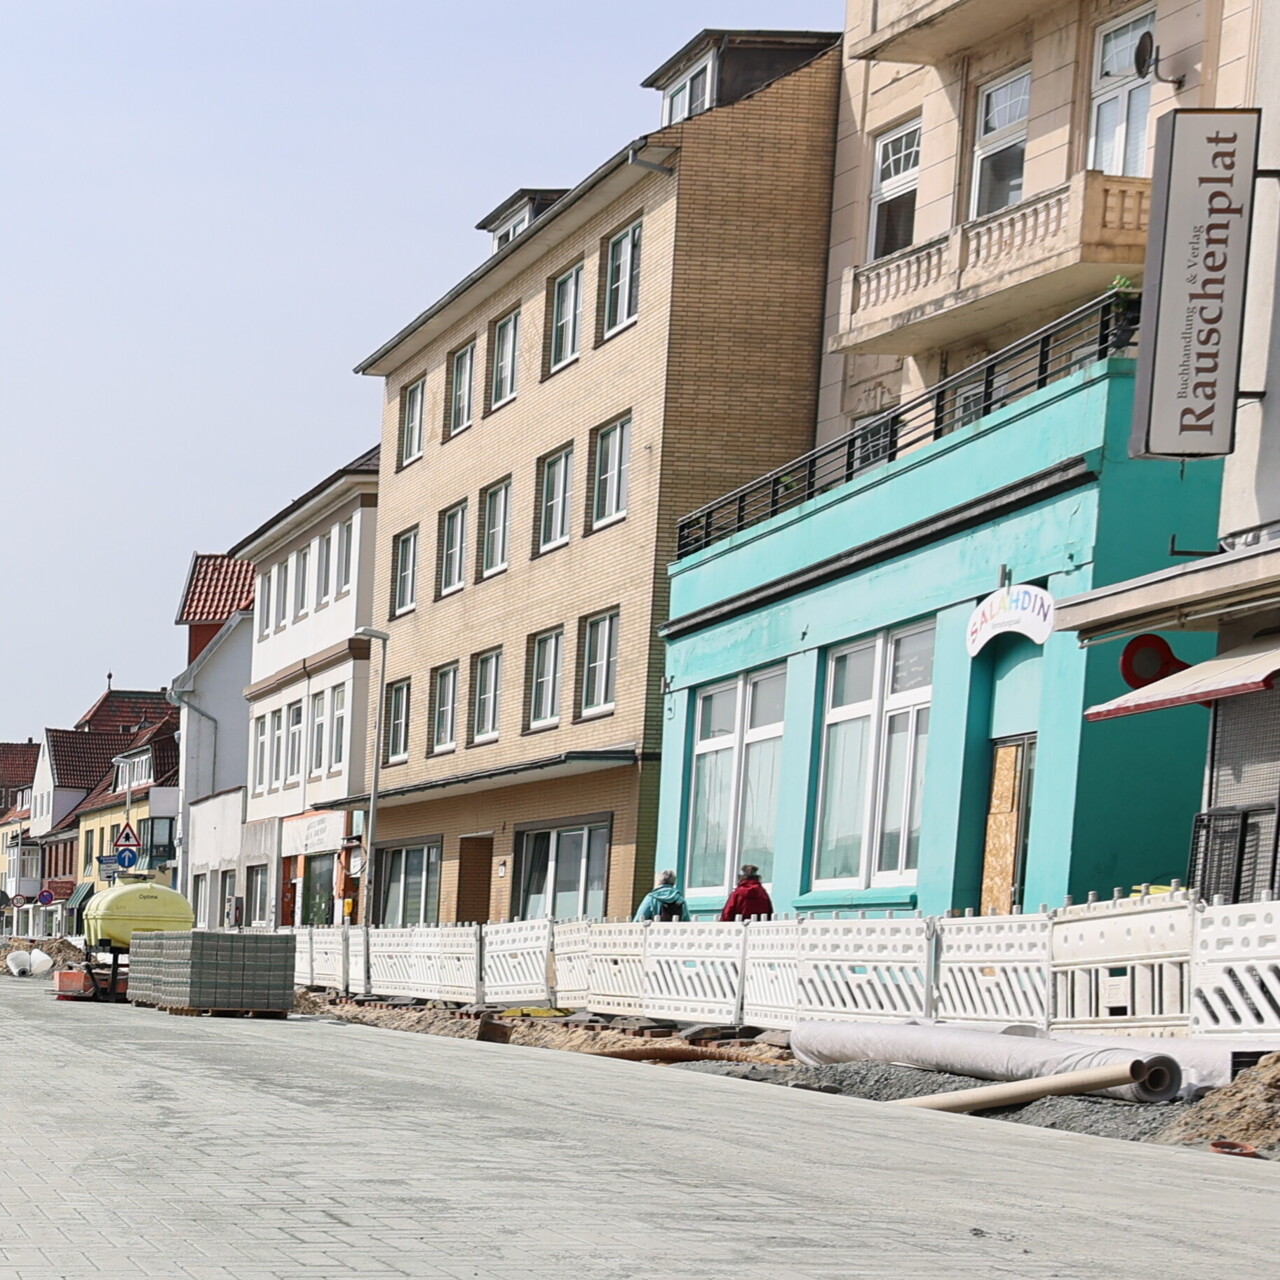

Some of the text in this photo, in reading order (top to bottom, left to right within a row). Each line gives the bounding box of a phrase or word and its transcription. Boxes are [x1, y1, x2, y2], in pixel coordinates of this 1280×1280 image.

[1177, 224, 1205, 400] Buchhandlung & Verlag
[1179, 130, 1243, 436] Rauschenplat
[970, 590, 1051, 644] SALAHDIN
[15, 897, 24, 905] 30
